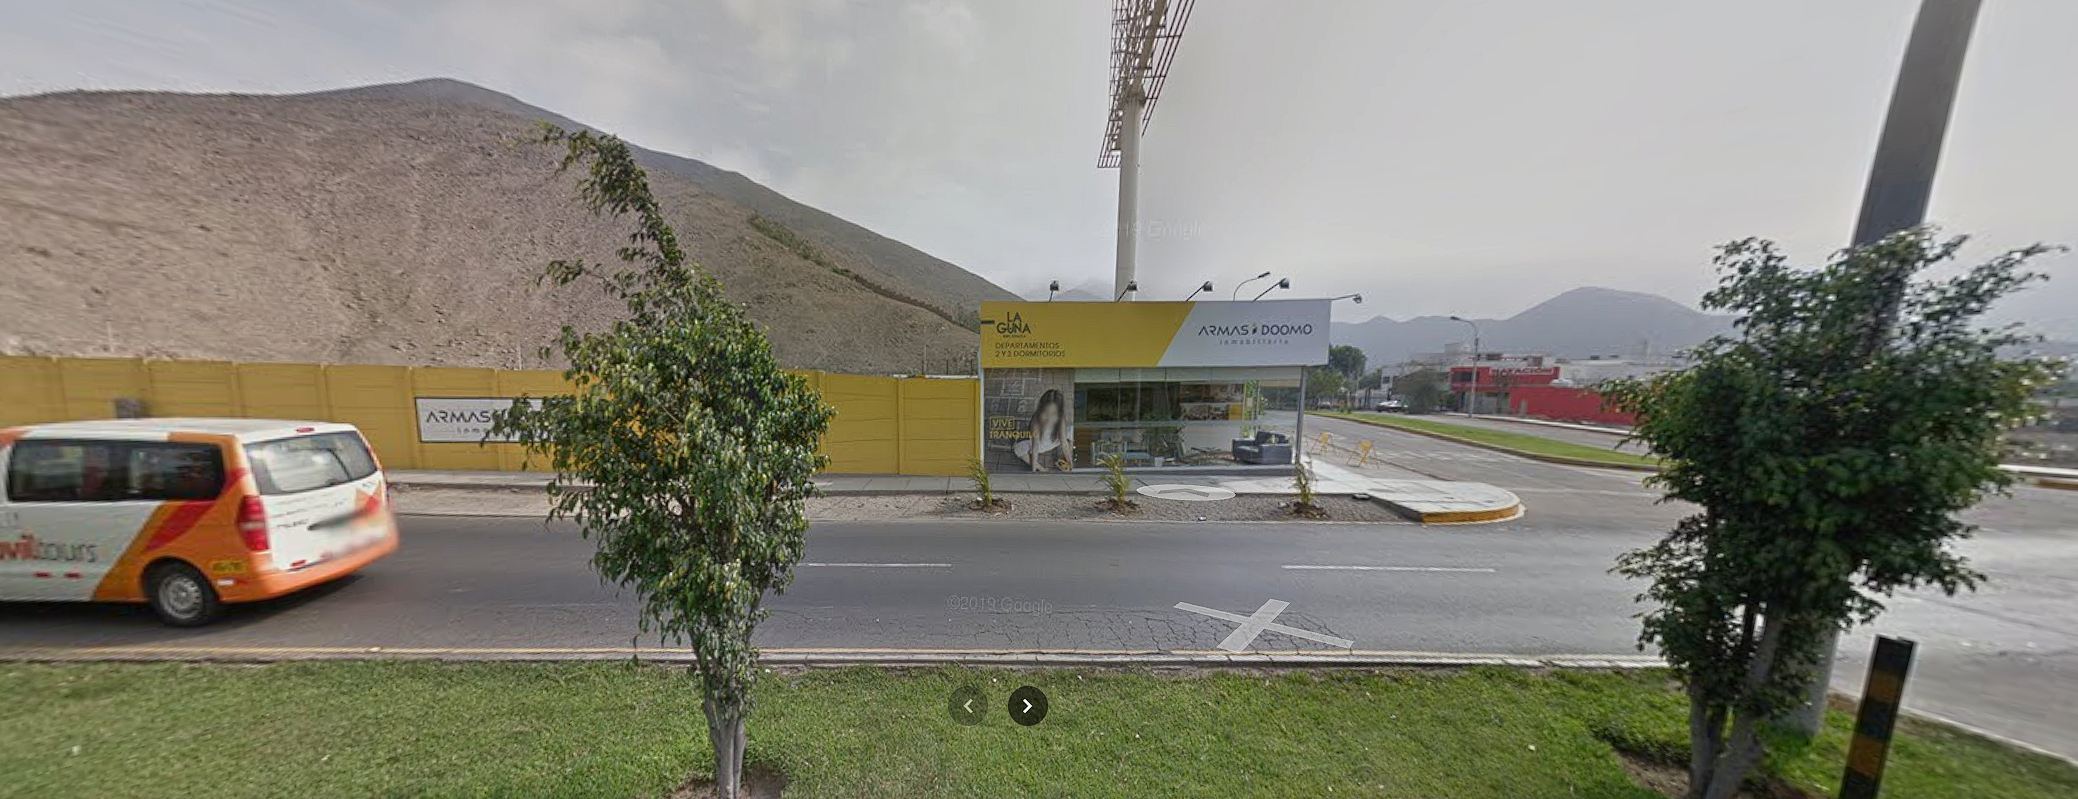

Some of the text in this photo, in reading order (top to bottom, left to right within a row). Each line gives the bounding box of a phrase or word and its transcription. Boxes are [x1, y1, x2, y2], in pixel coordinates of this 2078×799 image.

[1006, 311, 1022, 324] LA
[996, 323, 1032, 334] GUNA
[1198, 323, 1314, 337] ARMAS DOOMO
[995, 342, 1060, 350] DEPARTAMENTOS
[1014, 351, 1066, 359] DORMITORIOS
[426, 409, 491, 424] ARMAS
[992, 418, 1014, 428] VIVE
